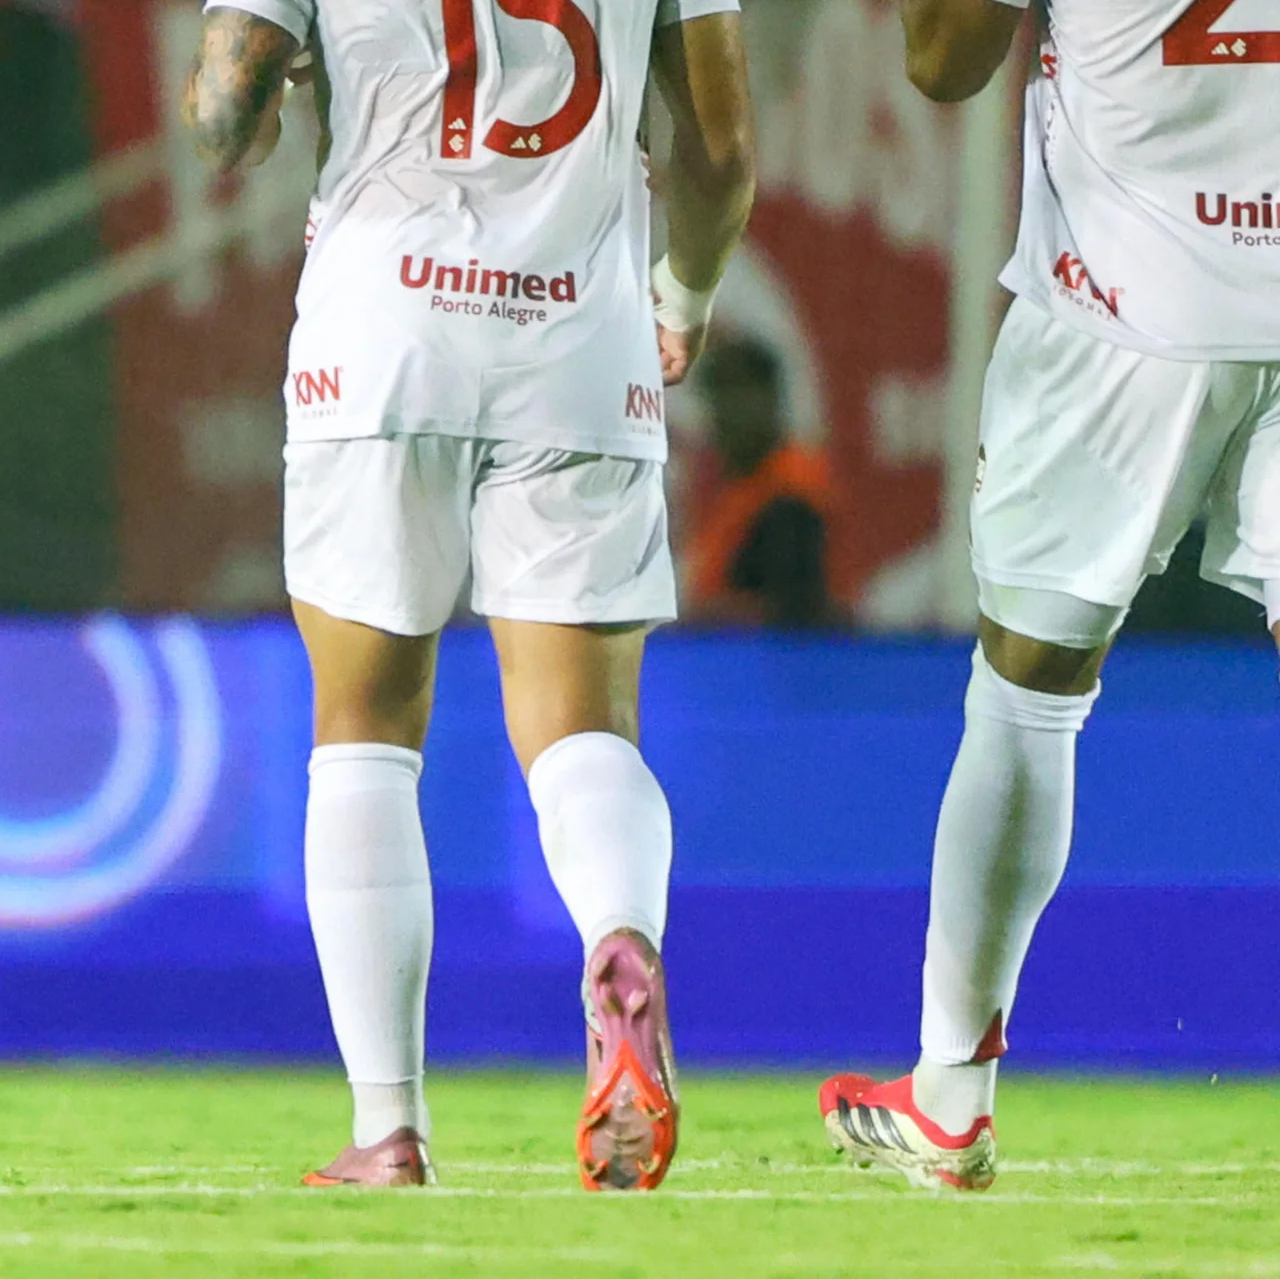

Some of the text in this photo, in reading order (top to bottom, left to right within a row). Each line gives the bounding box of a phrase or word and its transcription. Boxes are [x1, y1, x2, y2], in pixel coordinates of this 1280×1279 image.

[1195, 191, 1280, 229] Uni
[399, 255, 577, 303] Unimed
[430, 295, 547, 326] Porto Alegre
